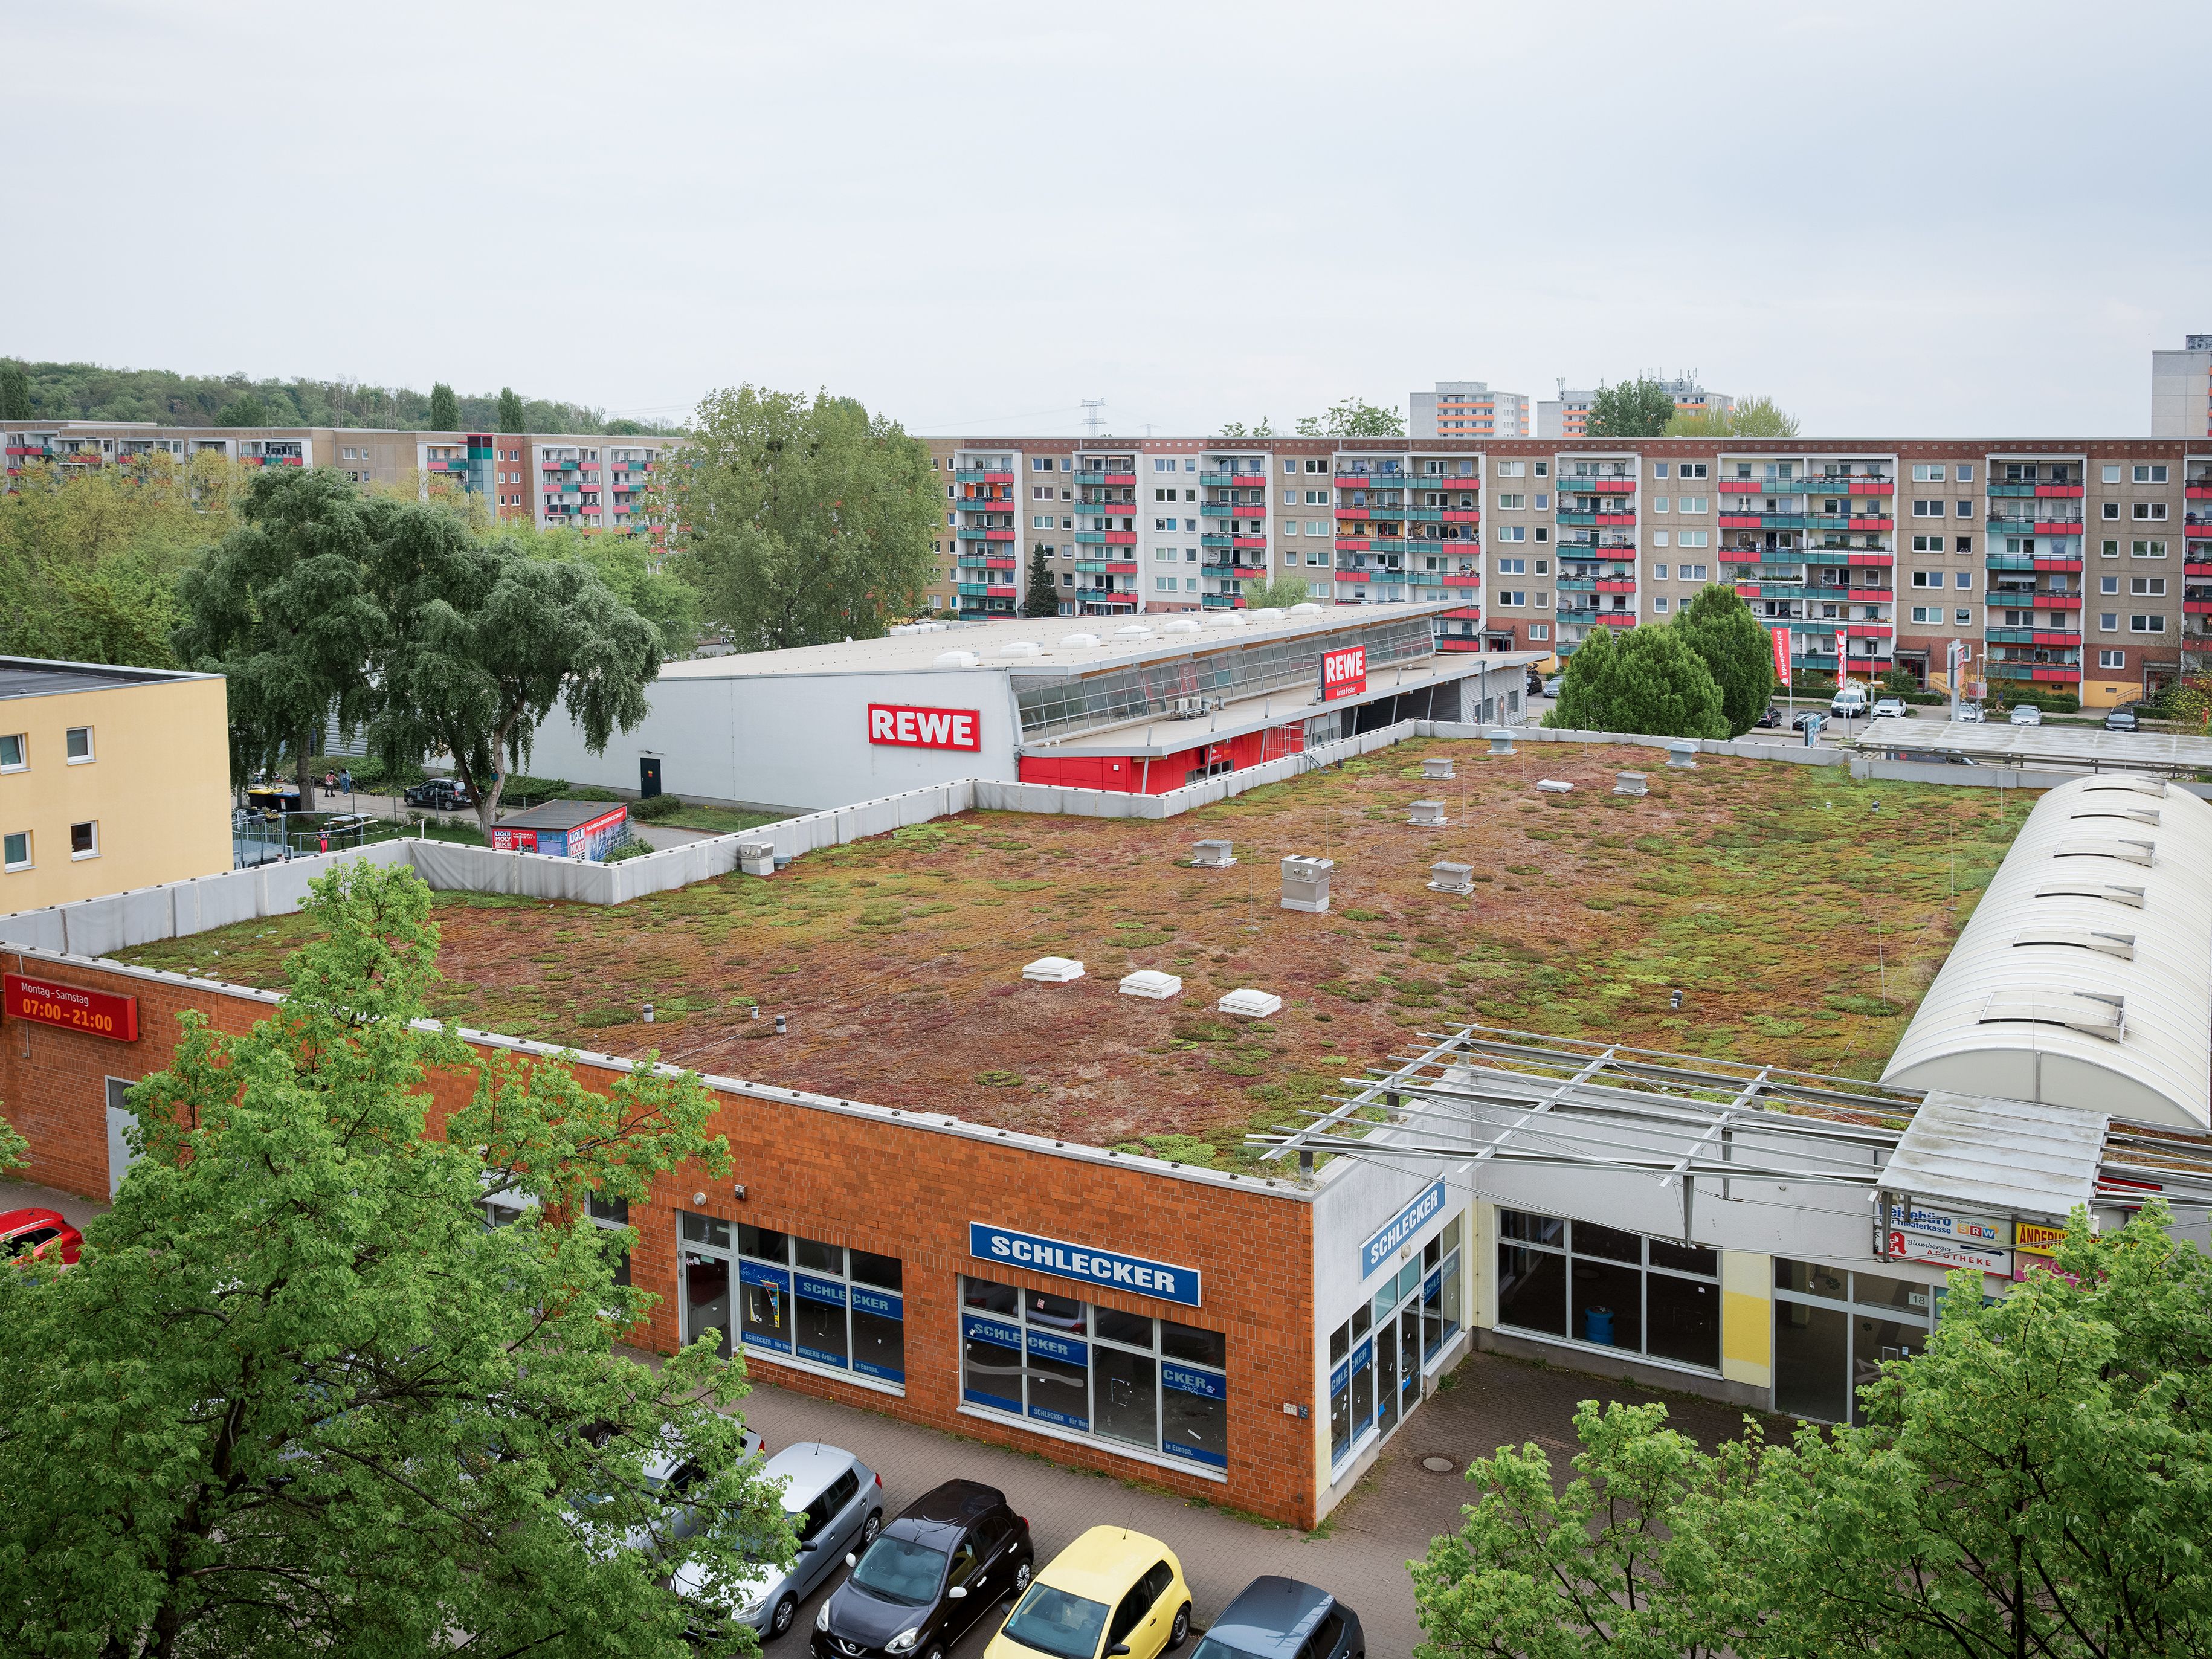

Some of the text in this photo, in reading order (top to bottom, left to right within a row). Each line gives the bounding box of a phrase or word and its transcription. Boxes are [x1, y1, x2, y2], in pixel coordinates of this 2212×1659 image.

[1326, 651, 1364, 683] REWE
[872, 709, 973, 746] REWE
[570, 828, 584, 844] LIQUI
[570, 840, 585, 855] MOLY
[1370, 1189, 1438, 1264] SCHLECKER
[1907, 1239, 1953, 1252] Blumberger
[991, 1235, 1175, 1293] SCHLECKER
[1927, 1249, 1991, 1266] APOTHEKE
[1912, 1295, 1925, 1305] 18
[745, 1333, 772, 1345] SCHLECKER
[1163, 1370, 1206, 1388] CKER
[1034, 1408, 1064, 1422] SCHLECKER
[1172, 1444, 1193, 1455] Europa.
